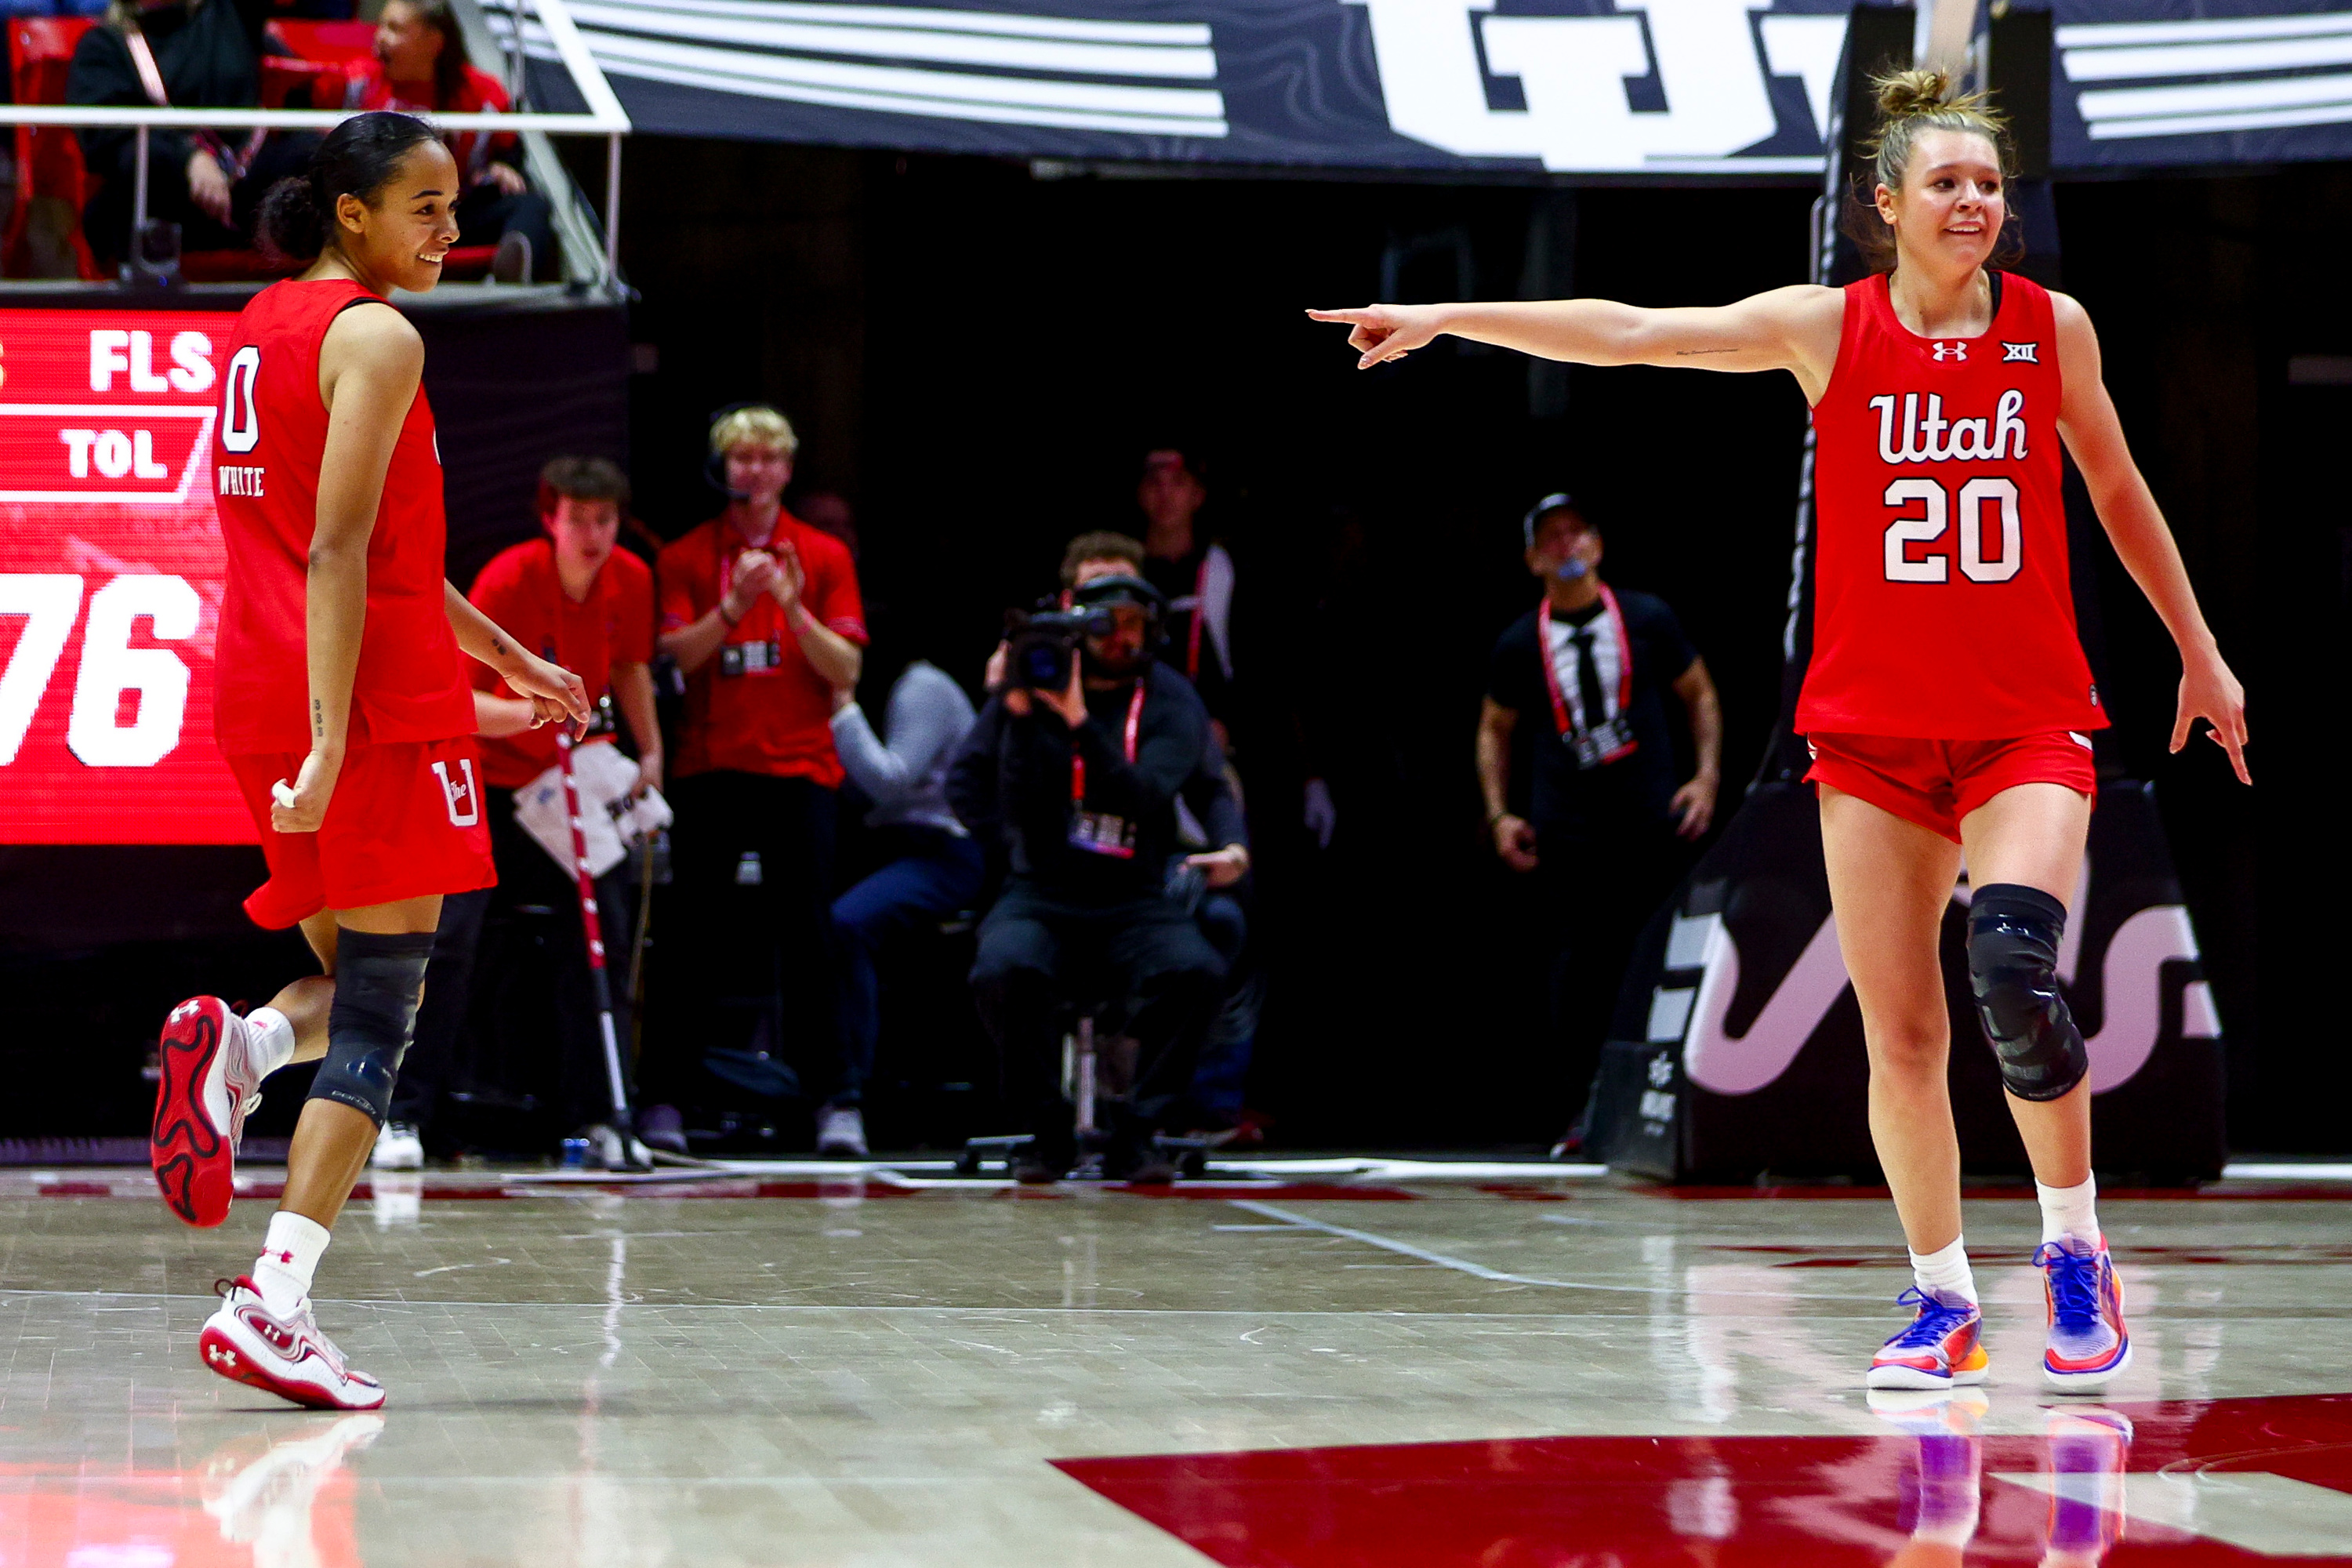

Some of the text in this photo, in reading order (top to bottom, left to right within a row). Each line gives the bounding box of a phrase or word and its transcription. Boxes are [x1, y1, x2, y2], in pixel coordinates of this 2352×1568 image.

[89, 328, 216, 392] FLS
[222, 344, 261, 453] 0
[1869, 389, 2029, 464] Utah
[58, 428, 168, 479] TOL
[218, 465, 265, 497] WHITE
[1883, 477, 2023, 583] 20
[0, 572, 201, 768] 76
[431, 758, 478, 827] U
